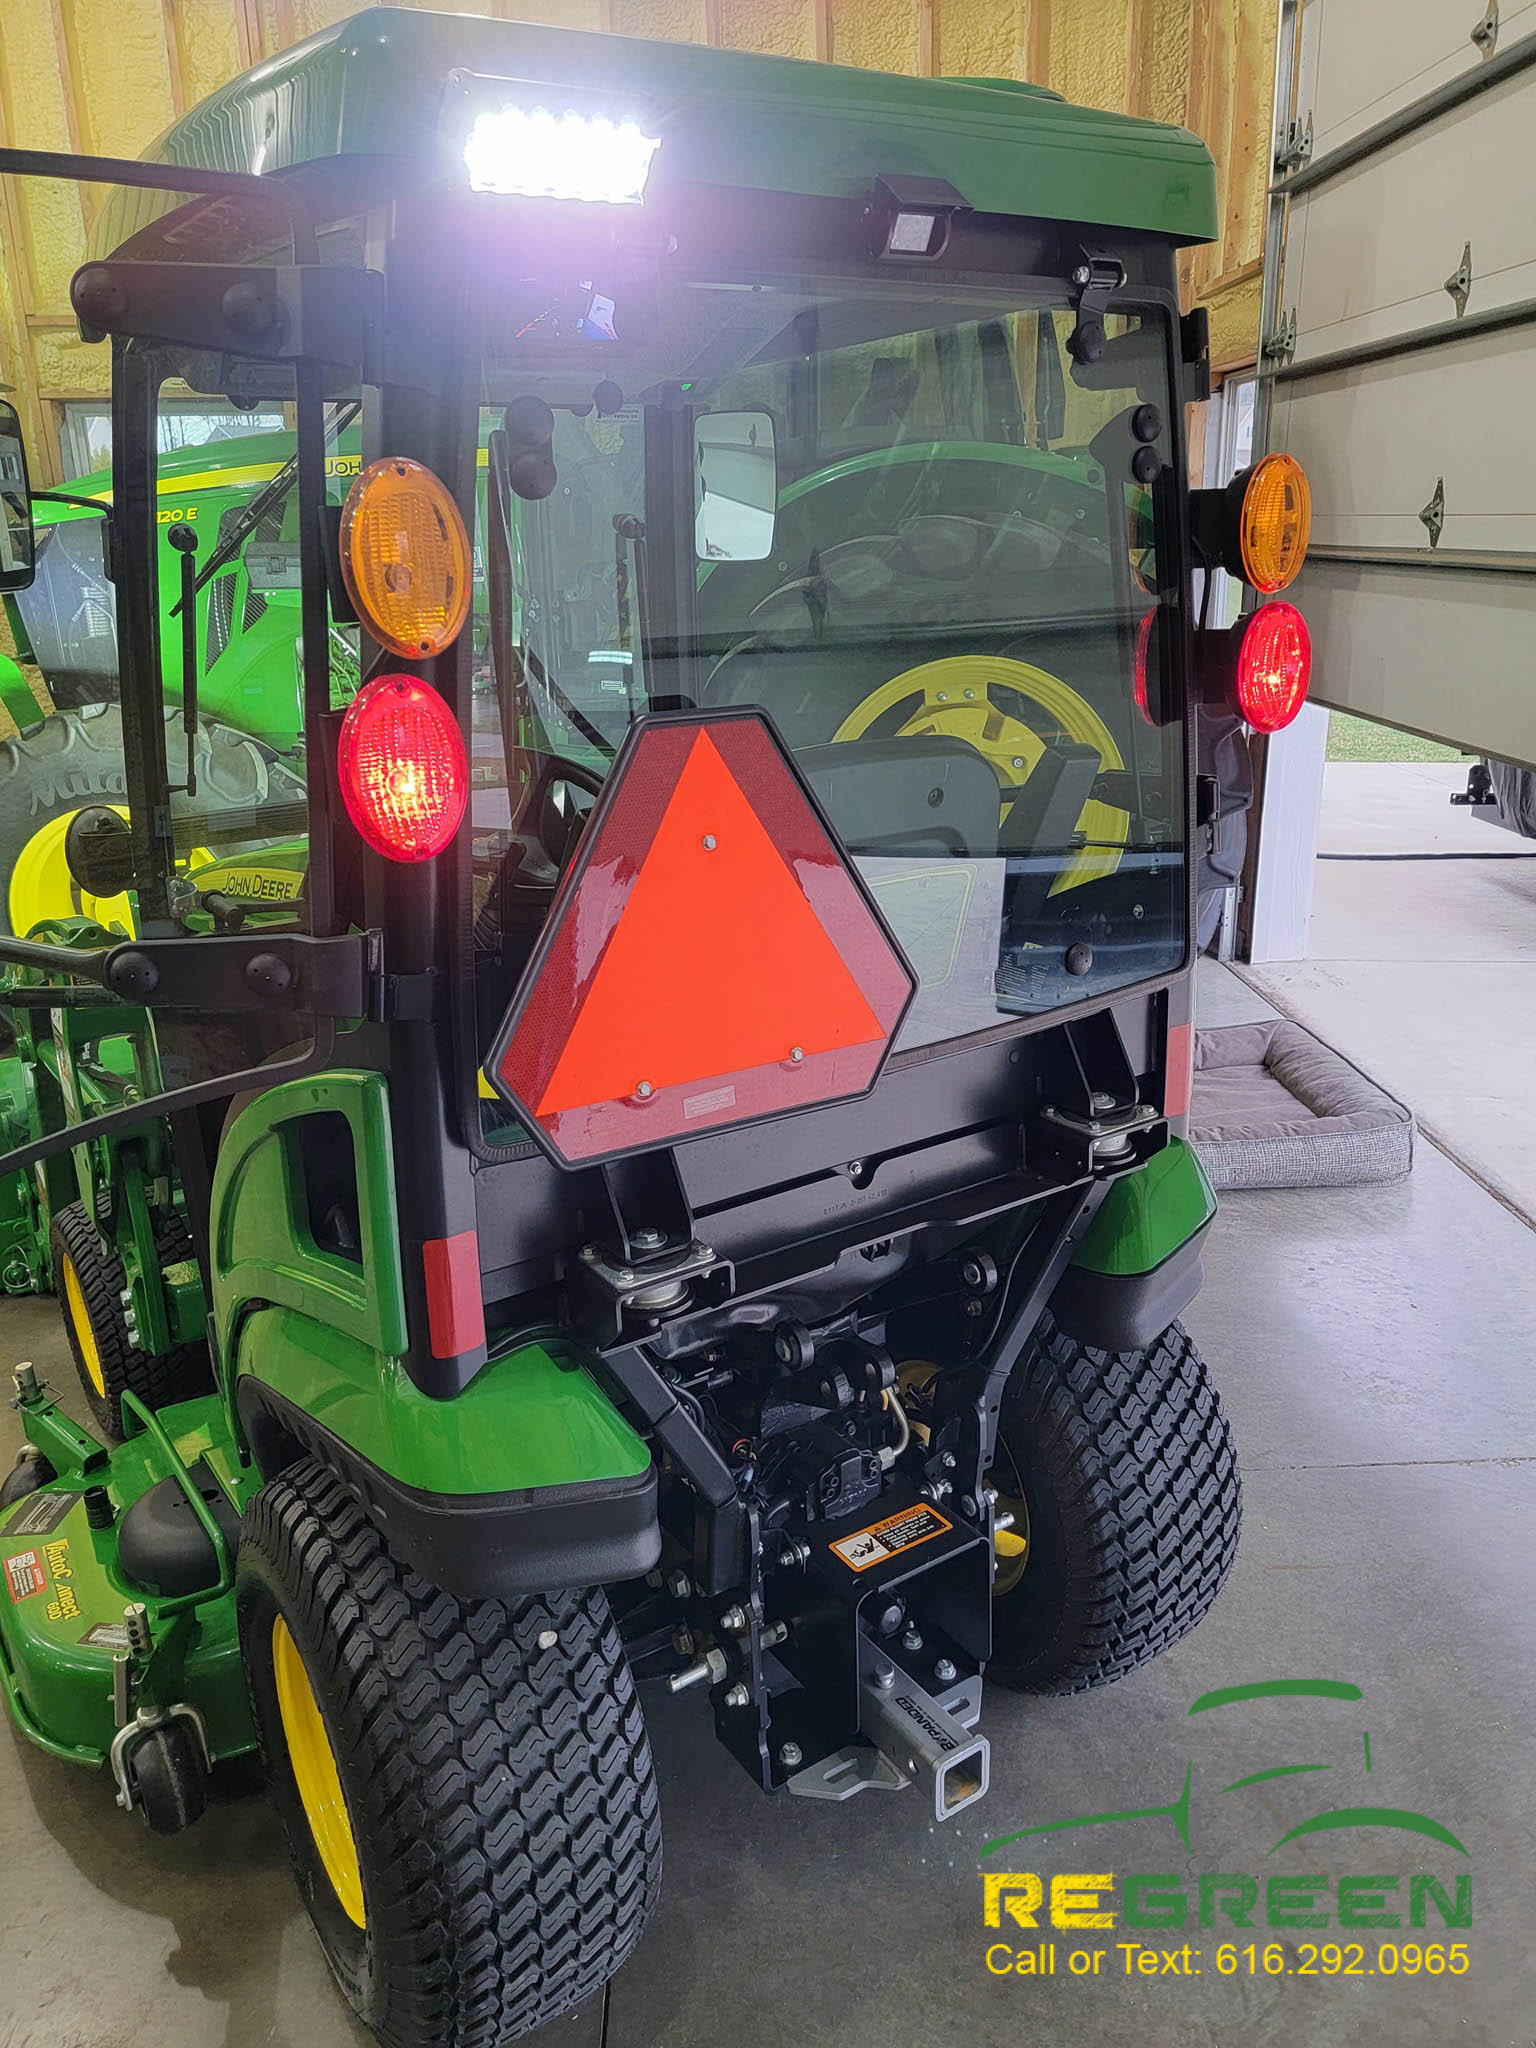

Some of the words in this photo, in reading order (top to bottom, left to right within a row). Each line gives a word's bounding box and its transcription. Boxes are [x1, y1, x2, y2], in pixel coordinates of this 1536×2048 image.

[325, 460, 362, 475] JOH
[253, 873, 294, 899] DEERE
[881, 1506, 921, 1529] WARNING
